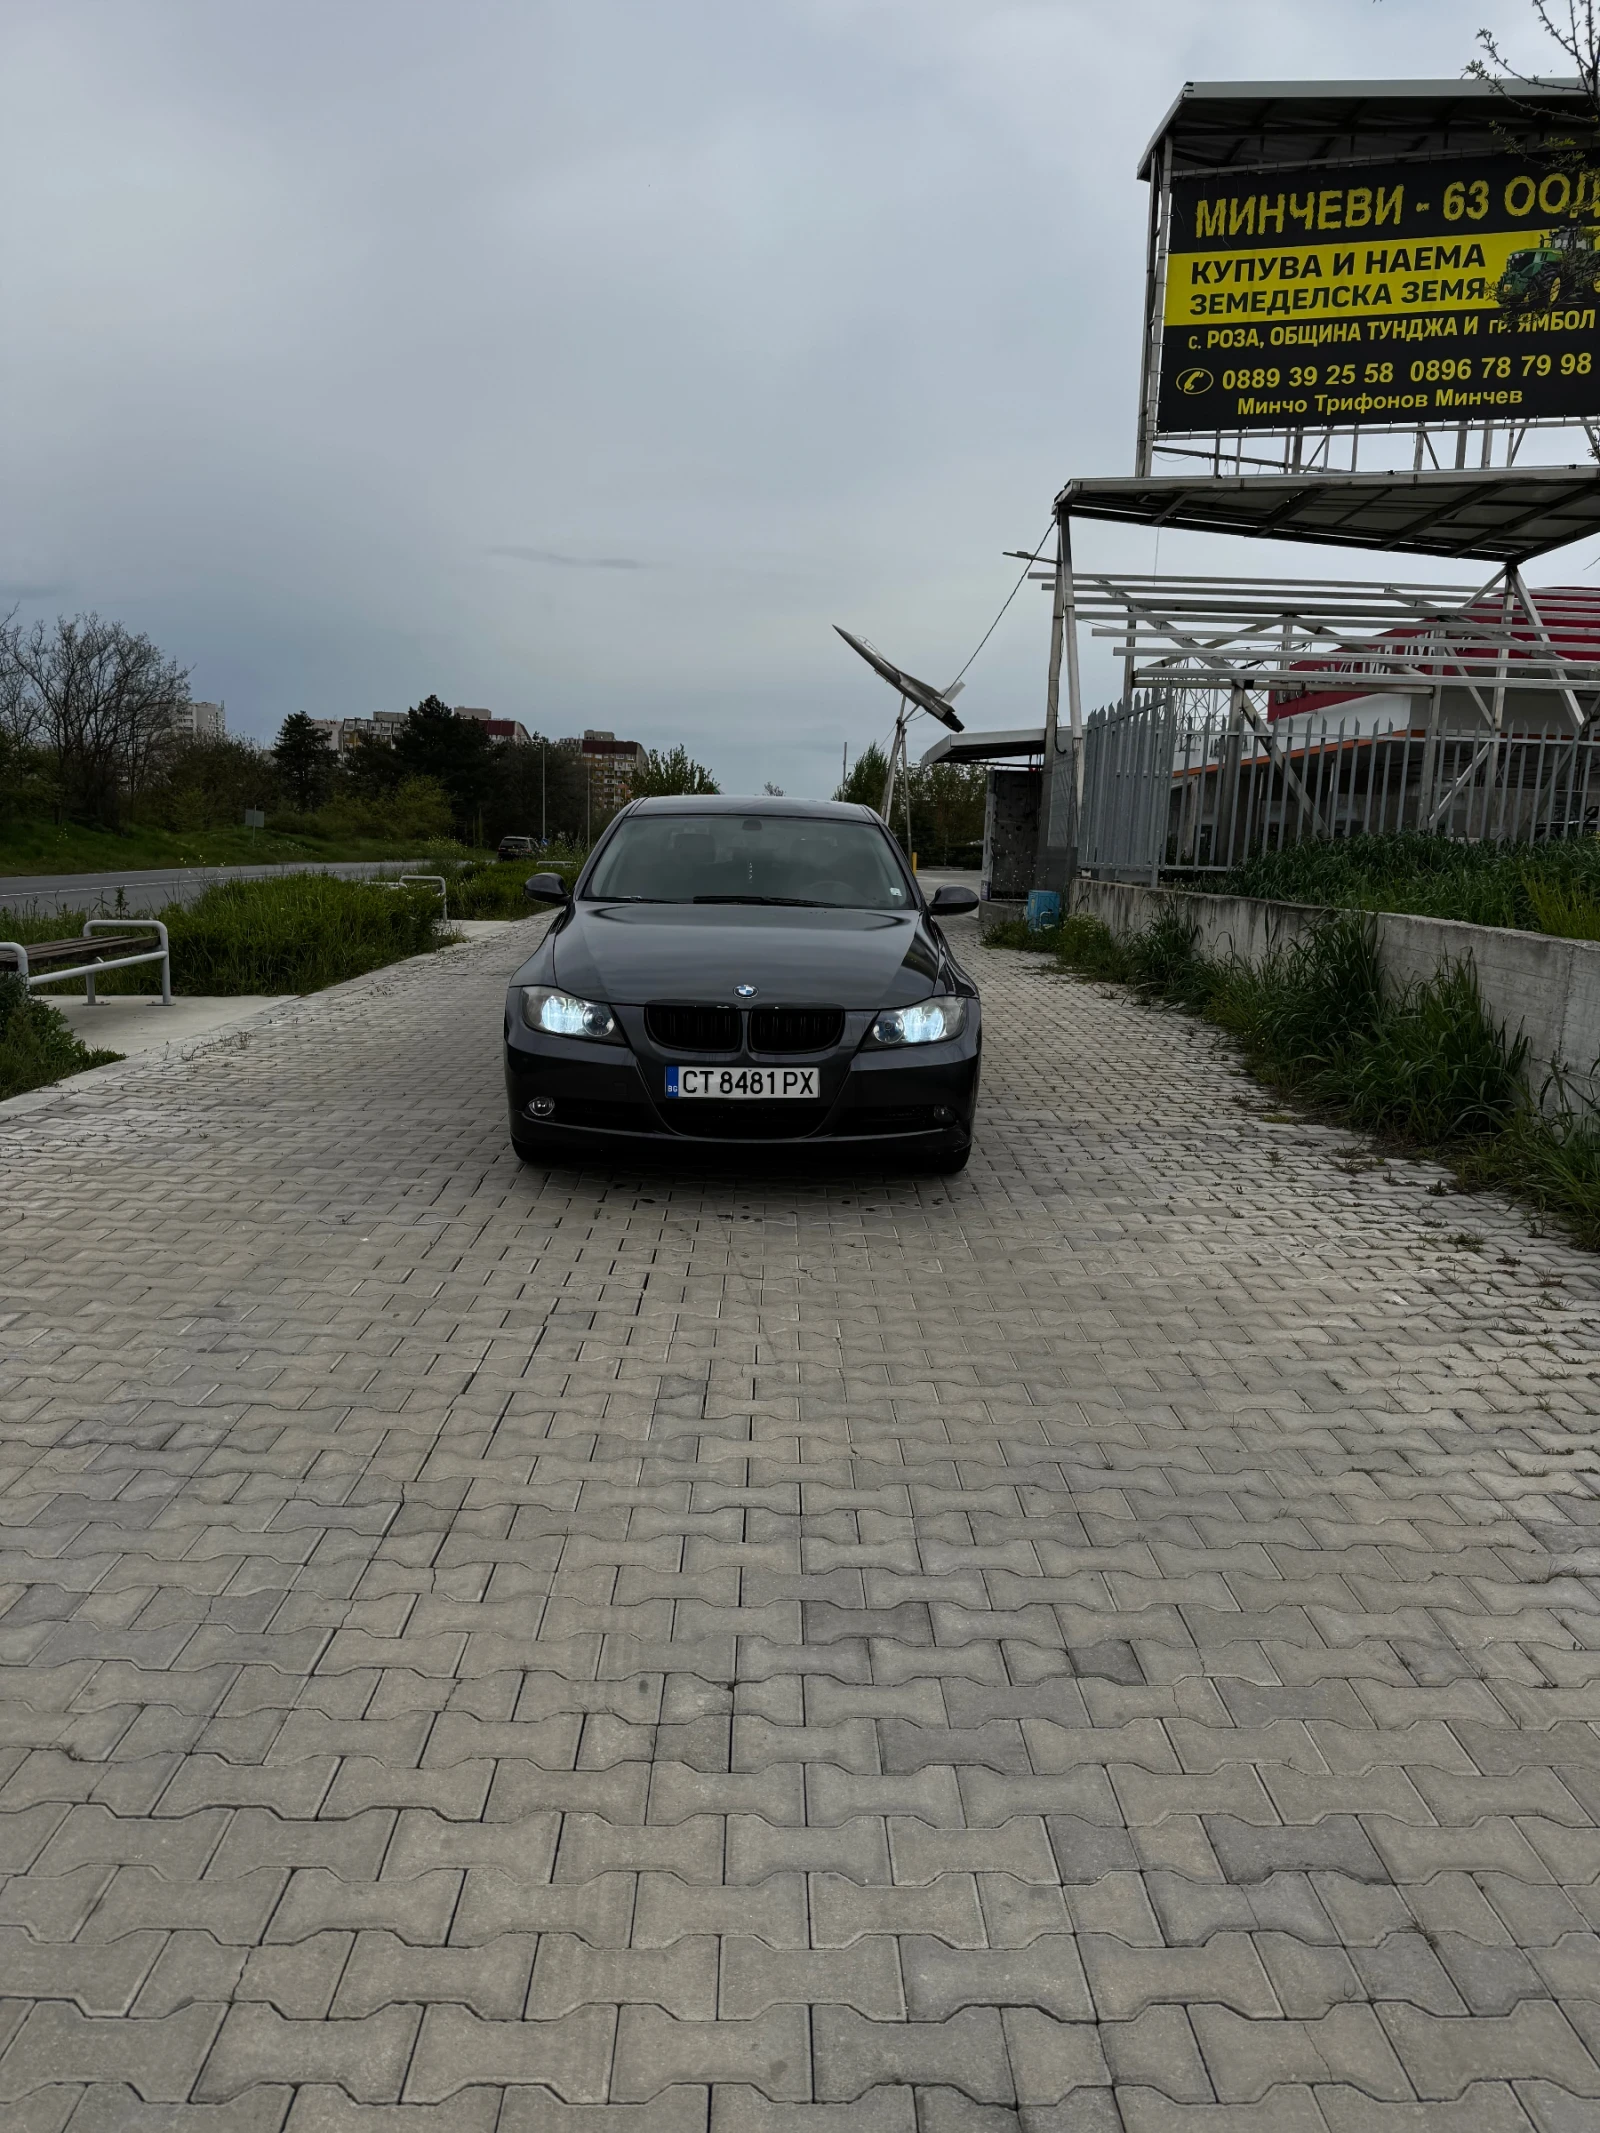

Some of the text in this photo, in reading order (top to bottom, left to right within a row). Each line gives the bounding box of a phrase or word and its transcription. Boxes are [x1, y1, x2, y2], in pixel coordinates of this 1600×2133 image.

[1195, 184, 1405, 238] МИНЧЕВИ
[1443, 180, 1489, 221] 63
[1191, 244, 1485, 285] КУПУВА И НАЕМА
[1189, 277, 1486, 316] ЗЕМЕДЕЛСКА ЗЕМЯ
[1207, 328, 1264, 349] РОЗА,
[1271, 322, 1361, 347] ОБЩИНА
[1367, 316, 1457, 342] ТУНДЖА
[1464, 316, 1478, 335] И
[1489, 319, 1511, 335] гр.
[1517, 309, 1595, 333] ЯМБОЛ
[1223, 352, 1592, 390] 0889 39 25 58 0896 78 79 98
[1238, 389, 1523, 415] Минчо Трифонов Минчев
[720, 1071, 775, 1094] 8481
